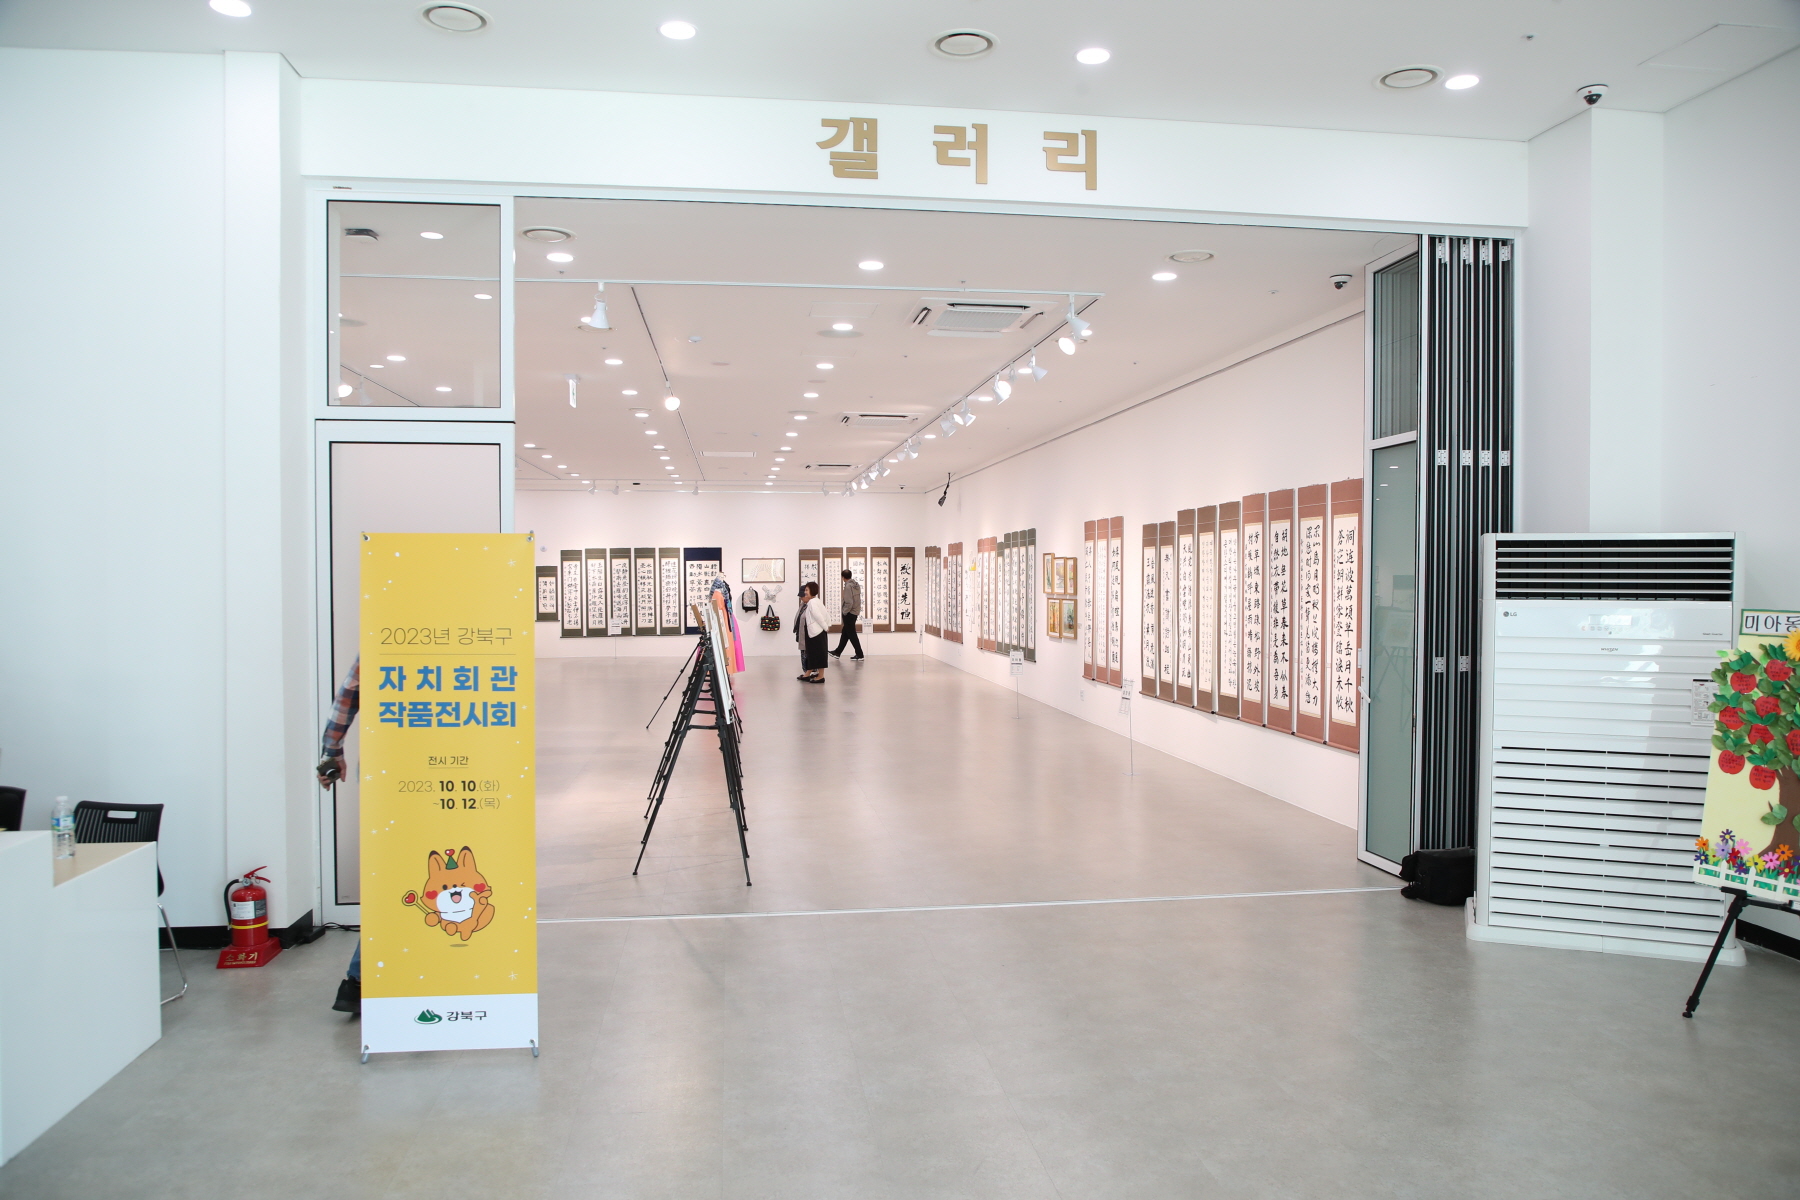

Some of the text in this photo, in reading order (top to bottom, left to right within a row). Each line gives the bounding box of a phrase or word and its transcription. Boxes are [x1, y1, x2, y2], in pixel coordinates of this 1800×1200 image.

[380, 627, 514, 646] 2023년 강북구
[378, 701, 517, 728] 작품전시회
[428, 756, 469, 766] 전시 기간
[398, 780, 436, 793] 2023.
[439, 780, 458, 792] 10.
[446, 1010, 488, 1022] 강북구
